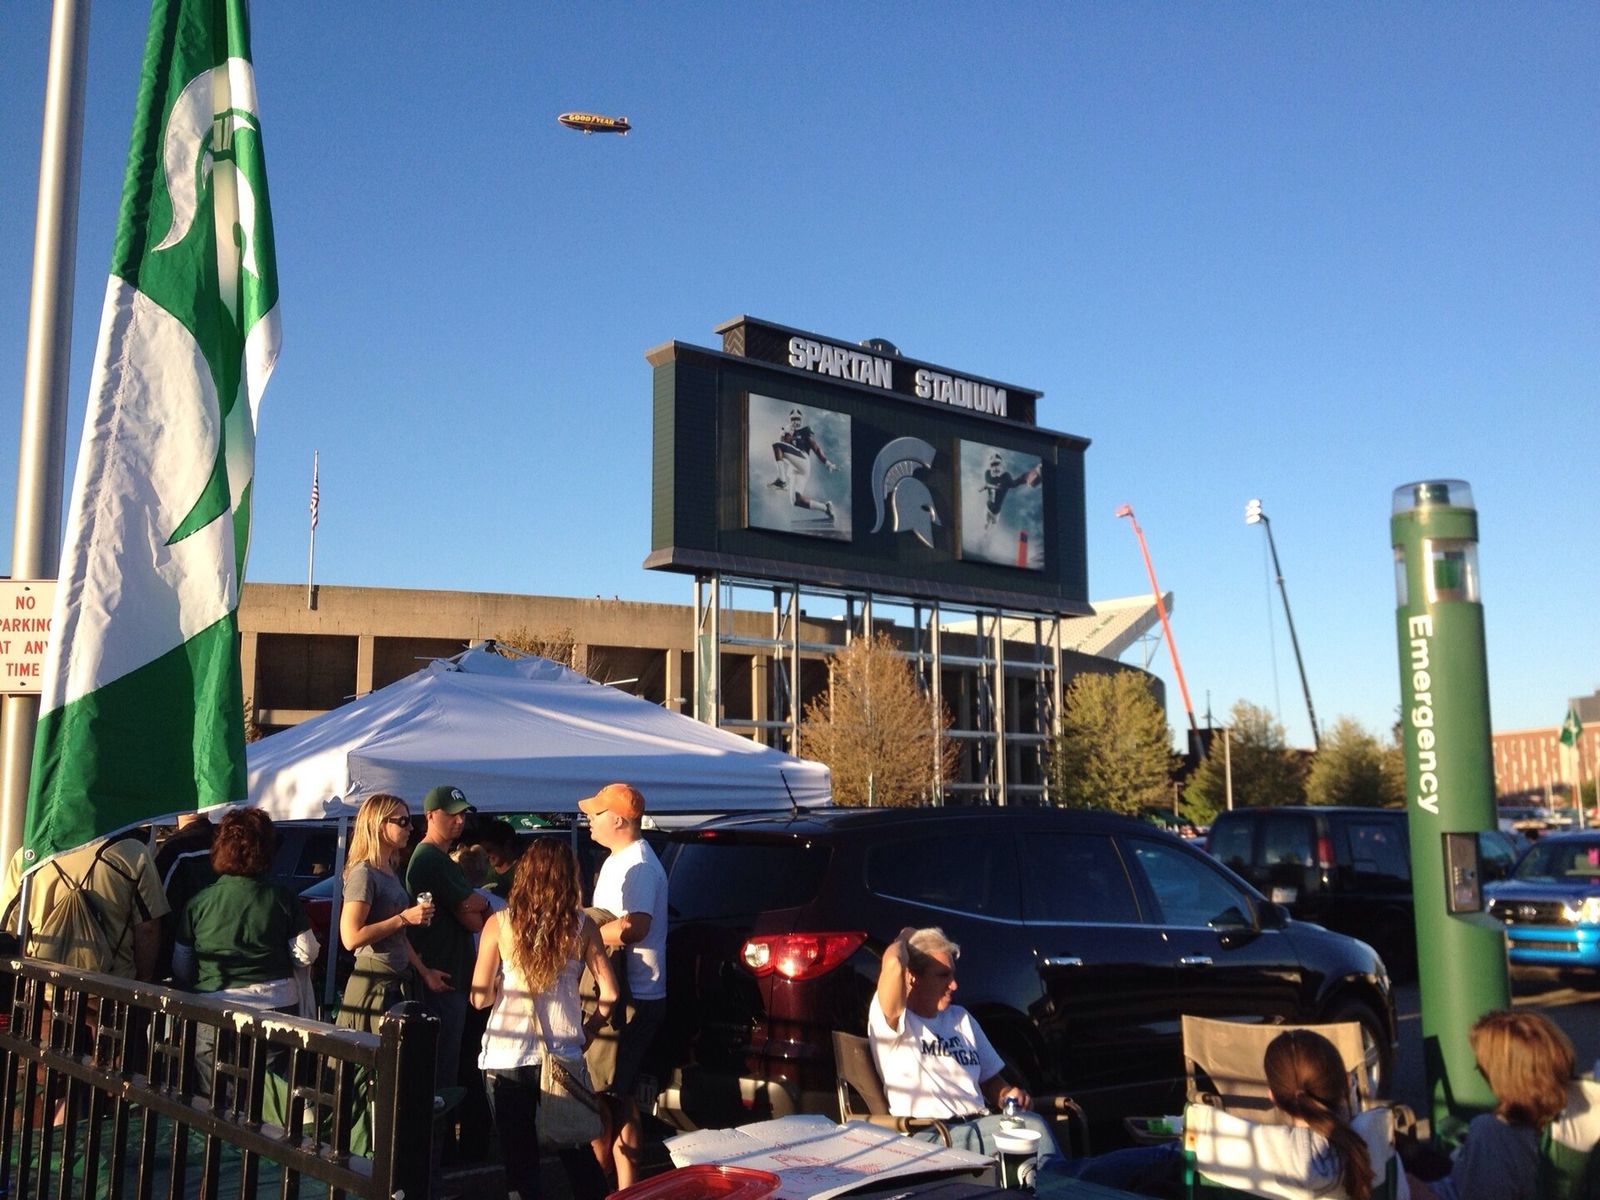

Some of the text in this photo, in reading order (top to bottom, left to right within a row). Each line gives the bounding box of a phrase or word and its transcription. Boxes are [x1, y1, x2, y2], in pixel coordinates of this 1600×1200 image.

[788, 336, 1007, 417] SPARTAN STADIUM
[15, 596, 36, 610] NO
[24, 640, 48, 654] AN
[6, 663, 39, 676] TIME
[1408, 614, 1439, 815] Emergency
